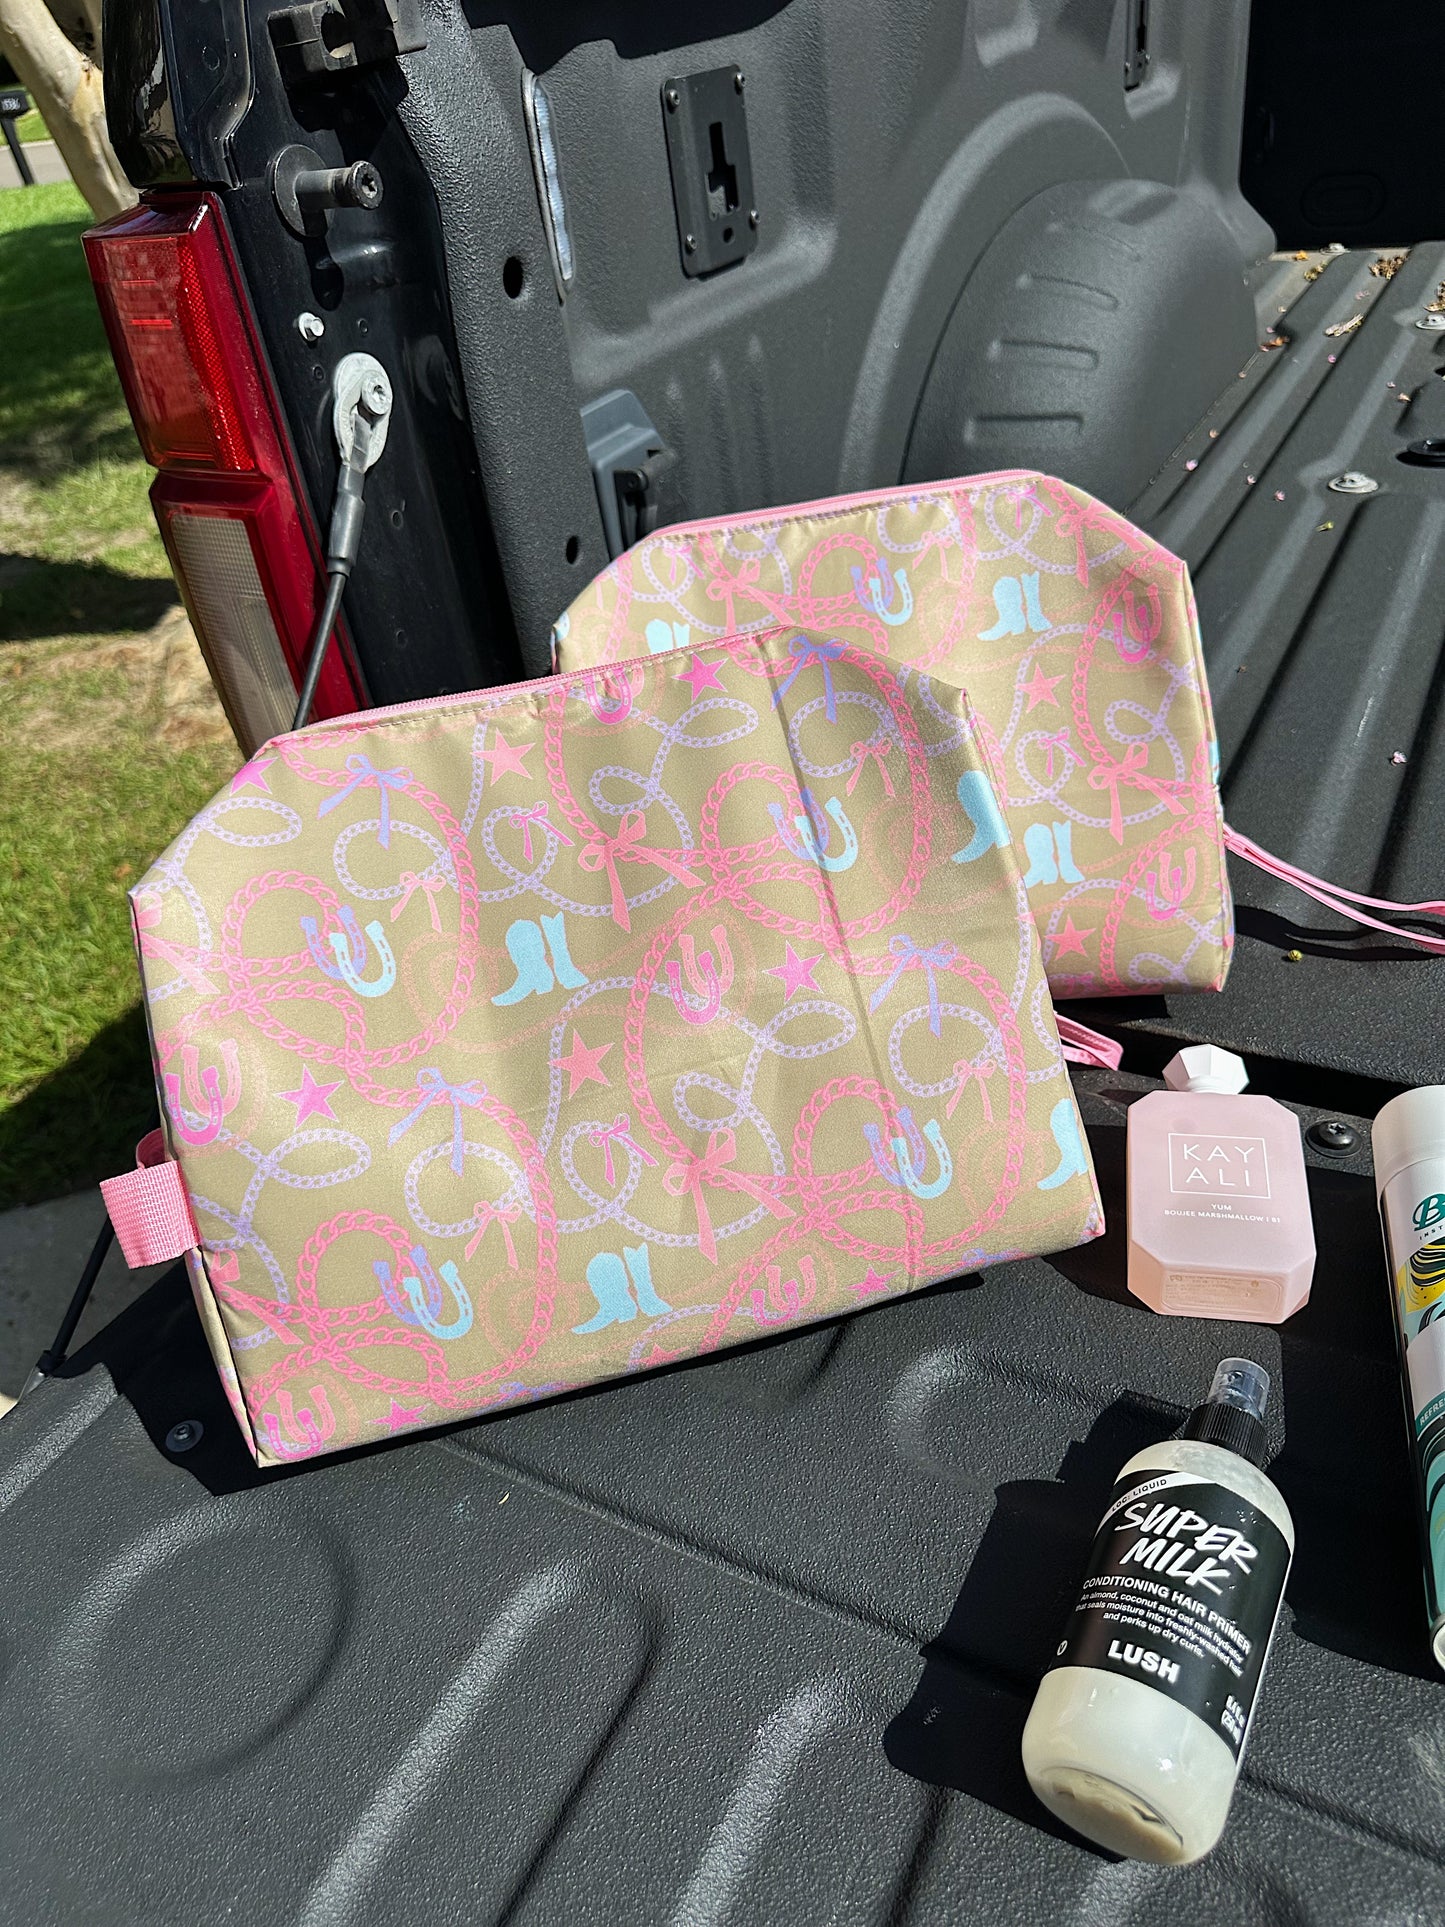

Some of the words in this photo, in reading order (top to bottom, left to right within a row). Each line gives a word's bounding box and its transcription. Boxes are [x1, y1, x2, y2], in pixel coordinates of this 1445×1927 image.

[1183, 1143, 1255, 1163] KAY
[1185, 1166, 1250, 1187] ALI
[1164, 1209, 1196, 1217] BOUJEE
[1198, 1211, 1264, 1222] MARSHMALLOW
[1211, 1203, 1232, 1211] YUM
[1420, 1397, 1445, 1426] REFRE
[1133, 1479, 1167, 1496] LIQUID
[1114, 1502, 1259, 1575] SUPER
[1119, 1537, 1231, 1596] MILK
[1083, 1576, 1169, 1599] CONDITIONING
[1171, 1590, 1207, 1617] HAIR
[1208, 1610, 1252, 1655] PRIMER
[1087, 1600, 1106, 1609] seals
[1106, 1602, 1145, 1616] moisture
[1145, 1609, 1165, 1624] into
[1166, 1617, 1231, 1666] freshly-washed
[1090, 1591, 1119, 1600] almond,
[1120, 1592, 1158, 1609] coconut
[1158, 1604, 1178, 1617] and
[1178, 1613, 1195, 1626] oat
[1194, 1621, 1214, 1639] milk
[1103, 1612, 1120, 1621] and
[1120, 1614, 1147, 1629] perks
[1148, 1623, 1162, 1635] up
[1162, 1629, 1181, 1644] dry
[1179, 1638, 1206, 1660] curls.
[1107, 1639, 1181, 1685] LUSH
